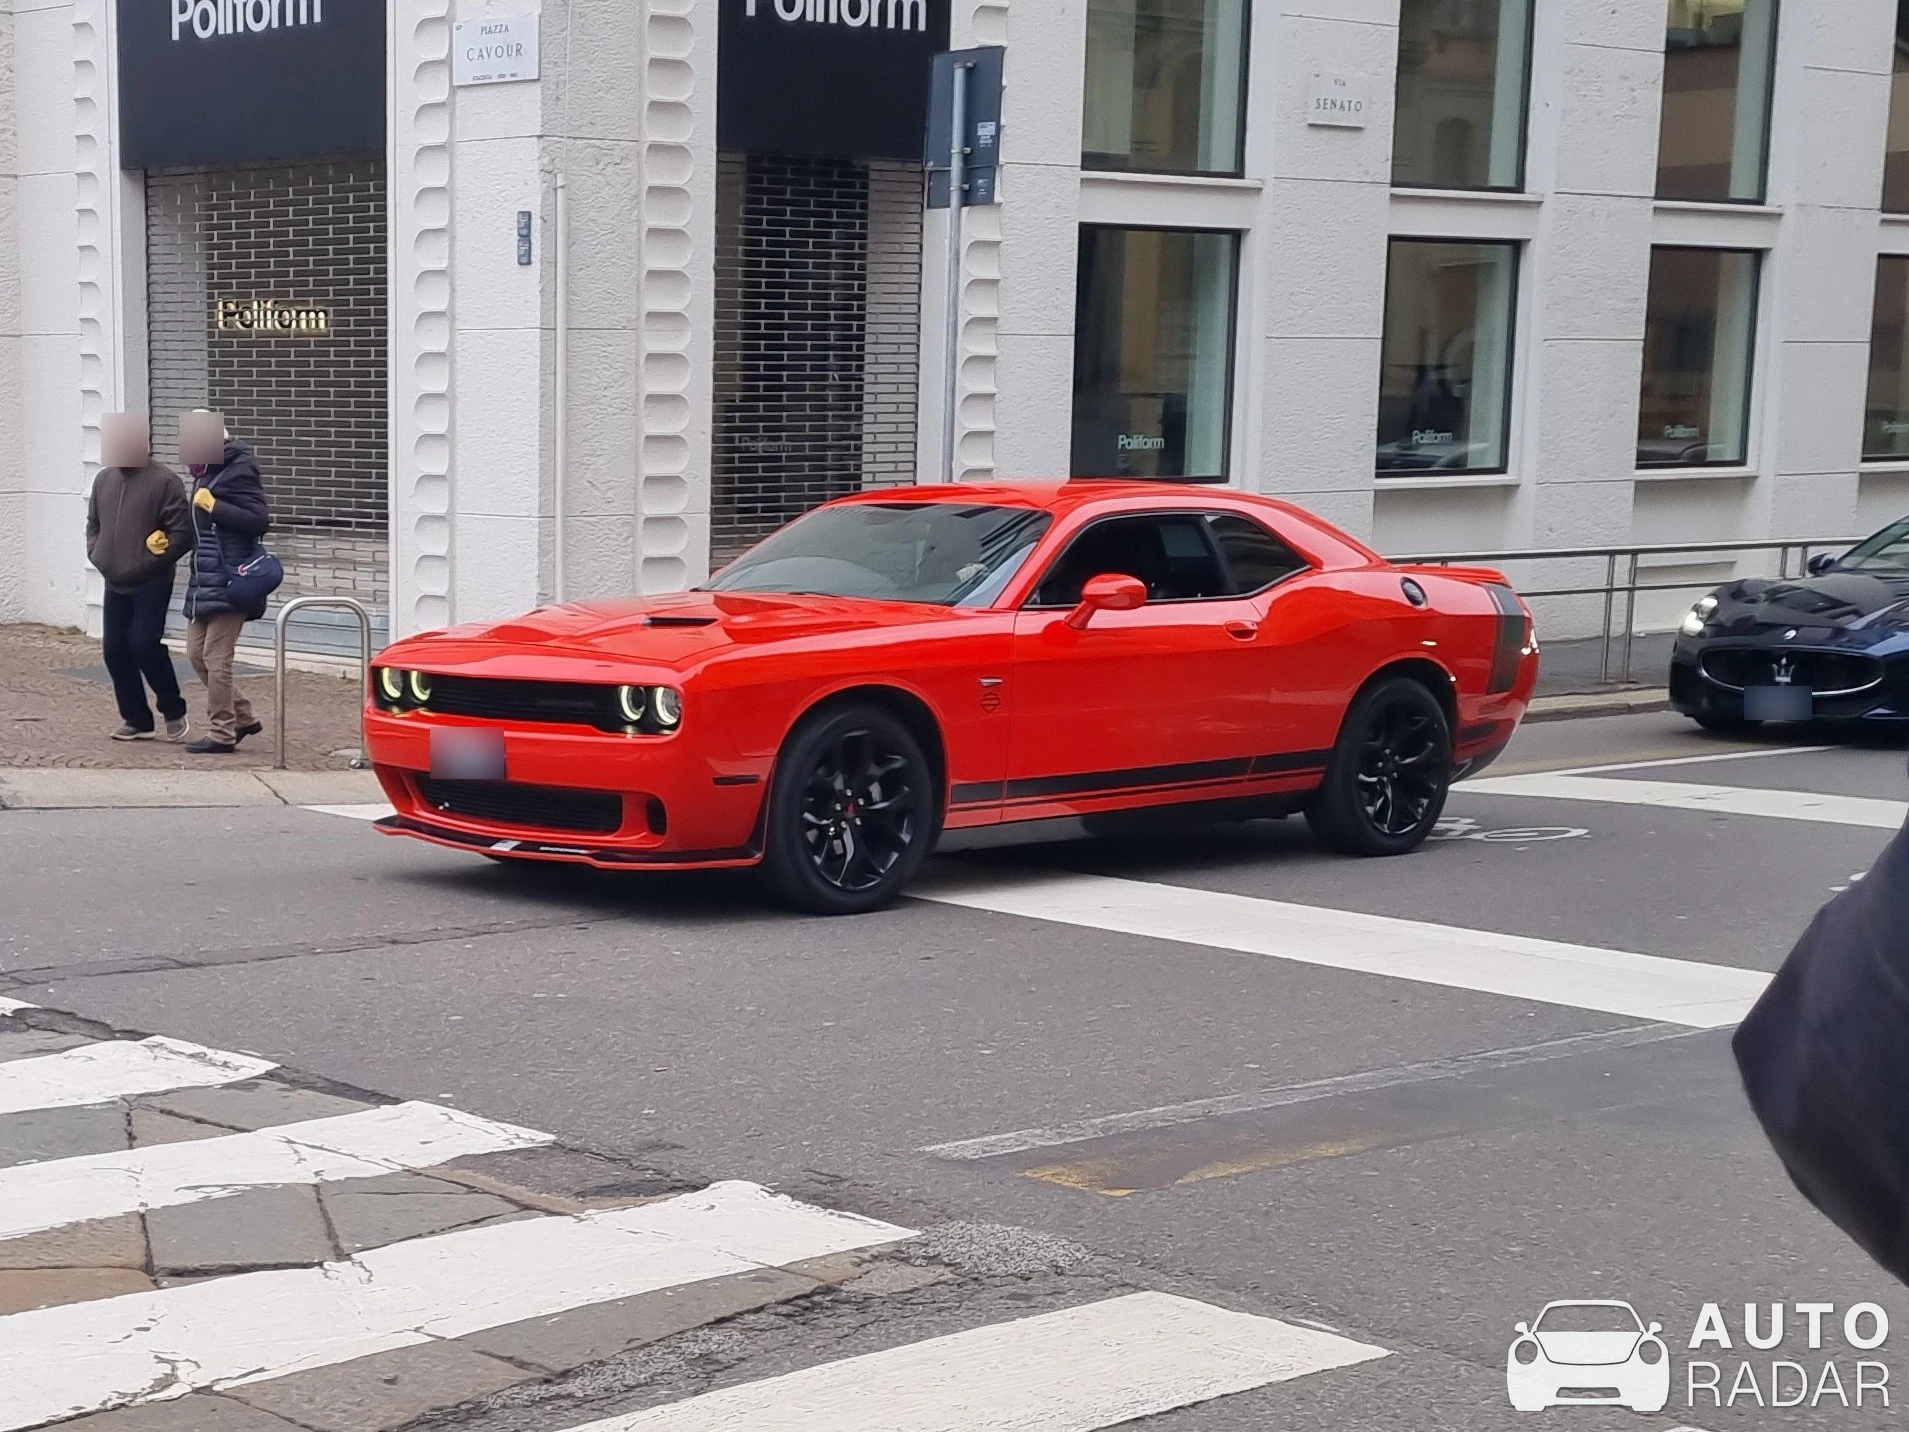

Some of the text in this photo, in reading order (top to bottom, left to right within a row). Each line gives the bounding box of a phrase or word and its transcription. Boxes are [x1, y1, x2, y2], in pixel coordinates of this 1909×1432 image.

[480, 24, 510, 35] PIAZZA
[466, 42, 523, 61] CAVOUR
[1314, 97, 1363, 112] SENATO
[217, 298, 328, 330] Poliform
[1117, 434, 1165, 450] Poliform
